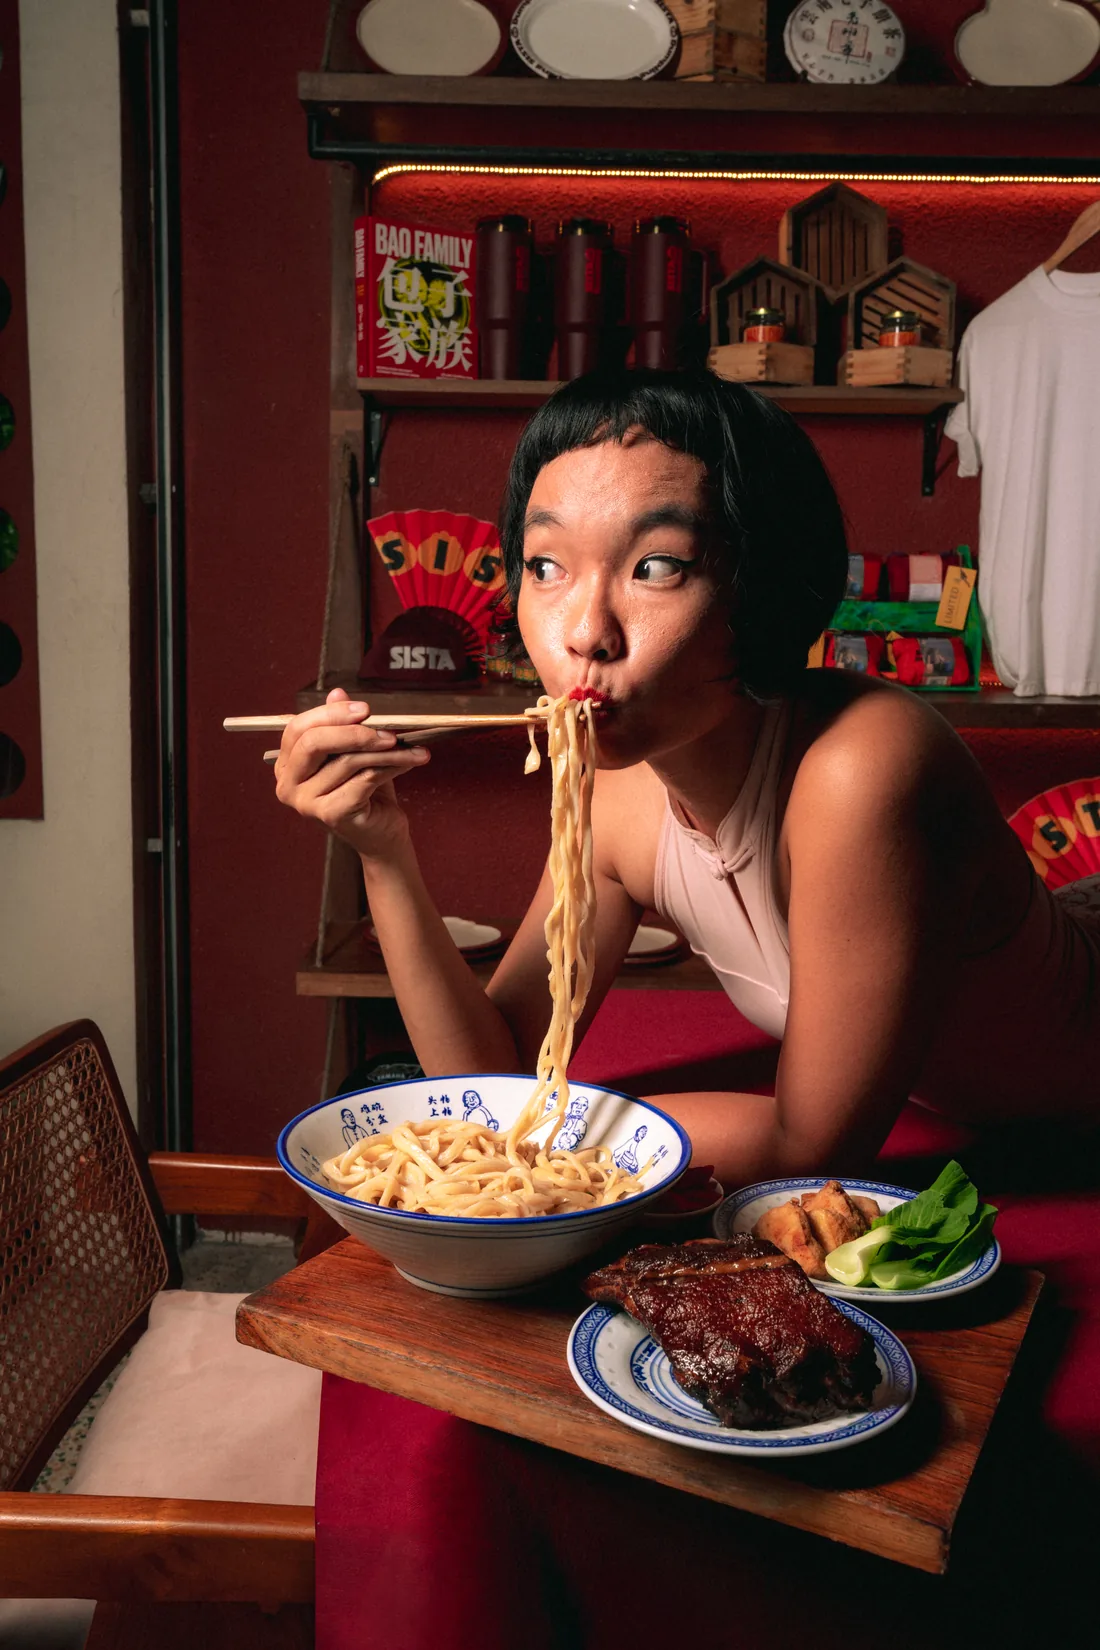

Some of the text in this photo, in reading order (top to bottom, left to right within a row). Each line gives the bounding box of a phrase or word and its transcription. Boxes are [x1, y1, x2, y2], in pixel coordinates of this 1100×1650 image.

[375, 223, 411, 258] BAO
[414, 230, 473, 269] FAMILY
[376, 257, 473, 318] 包子
[376, 312, 473, 372] 家族
[944, 586, 960, 624] LIMITED
[389, 646, 456, 670] SISTA
